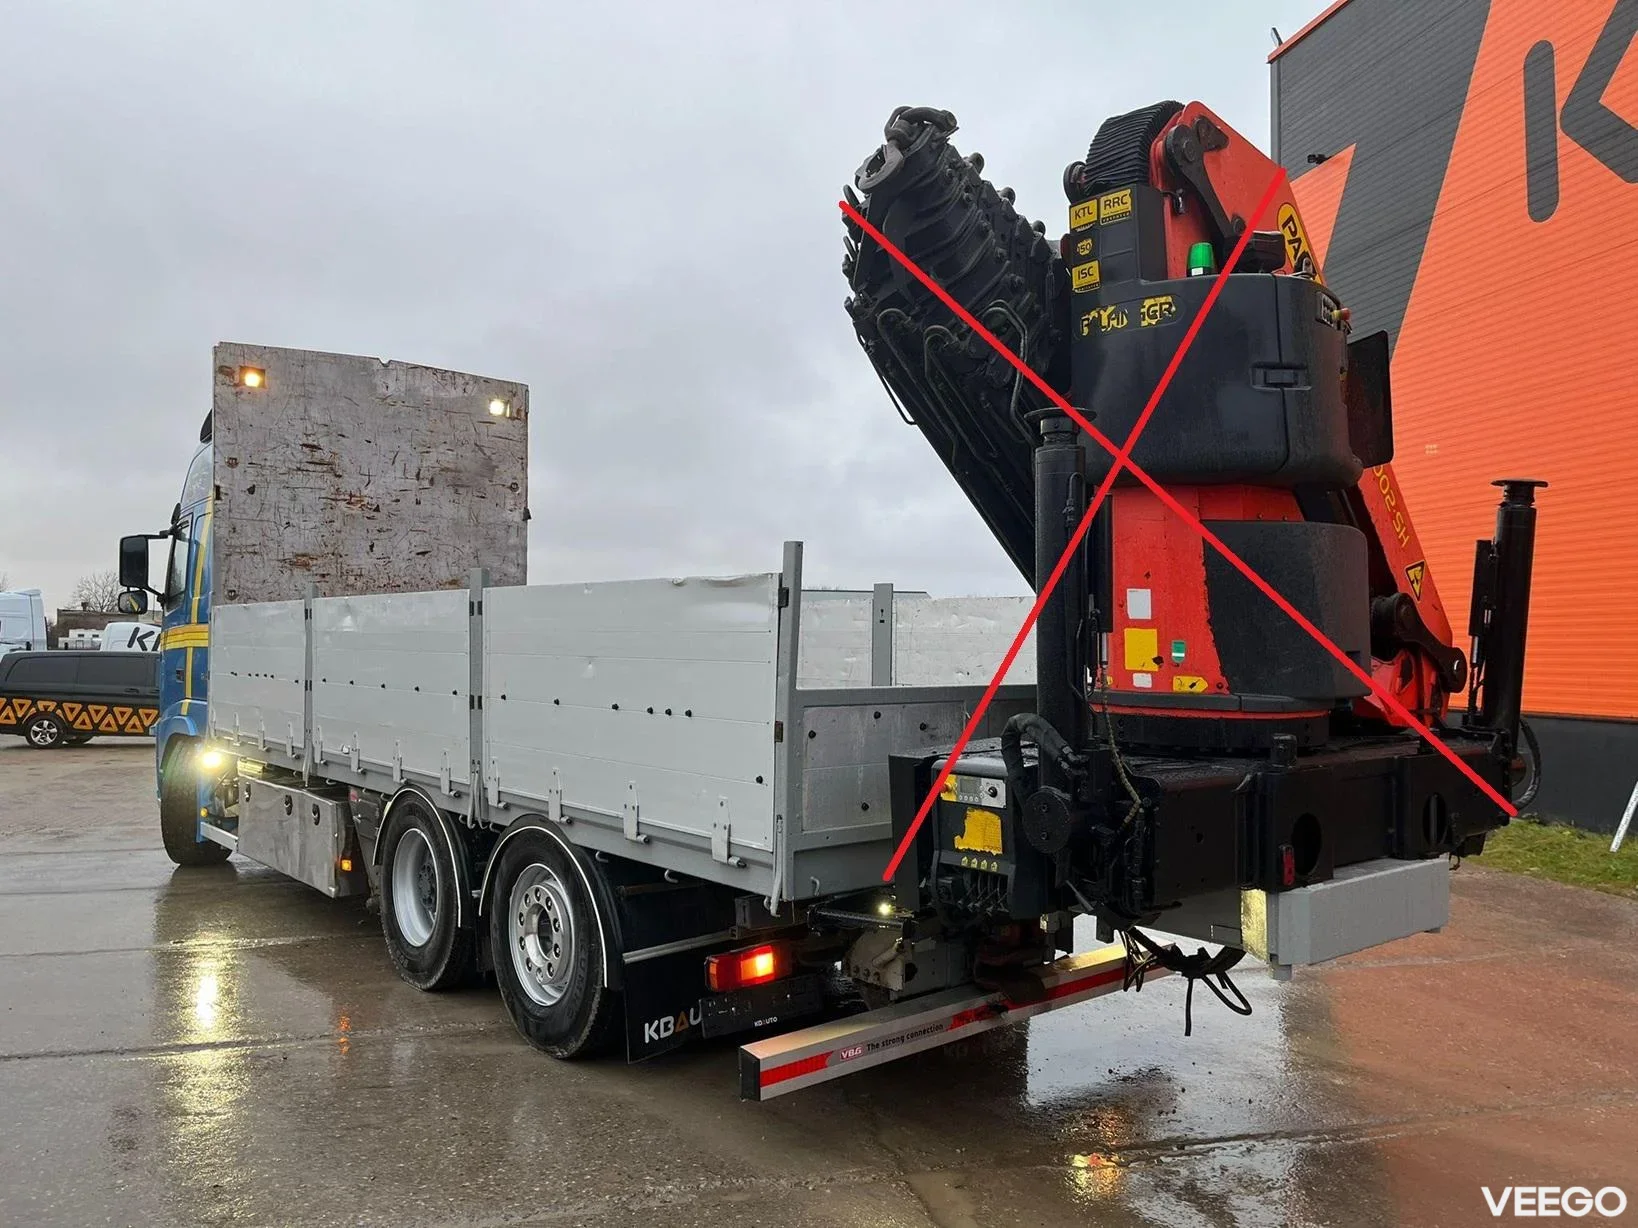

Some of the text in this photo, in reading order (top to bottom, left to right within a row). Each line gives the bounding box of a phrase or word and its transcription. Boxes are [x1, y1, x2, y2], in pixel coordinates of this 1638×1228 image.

[1103, 194, 1129, 211] RRC
[1074, 205, 1094, 221] KTL
[1077, 265, 1094, 281] ISC
[841, 1023, 944, 1059] VBG The strong connection
